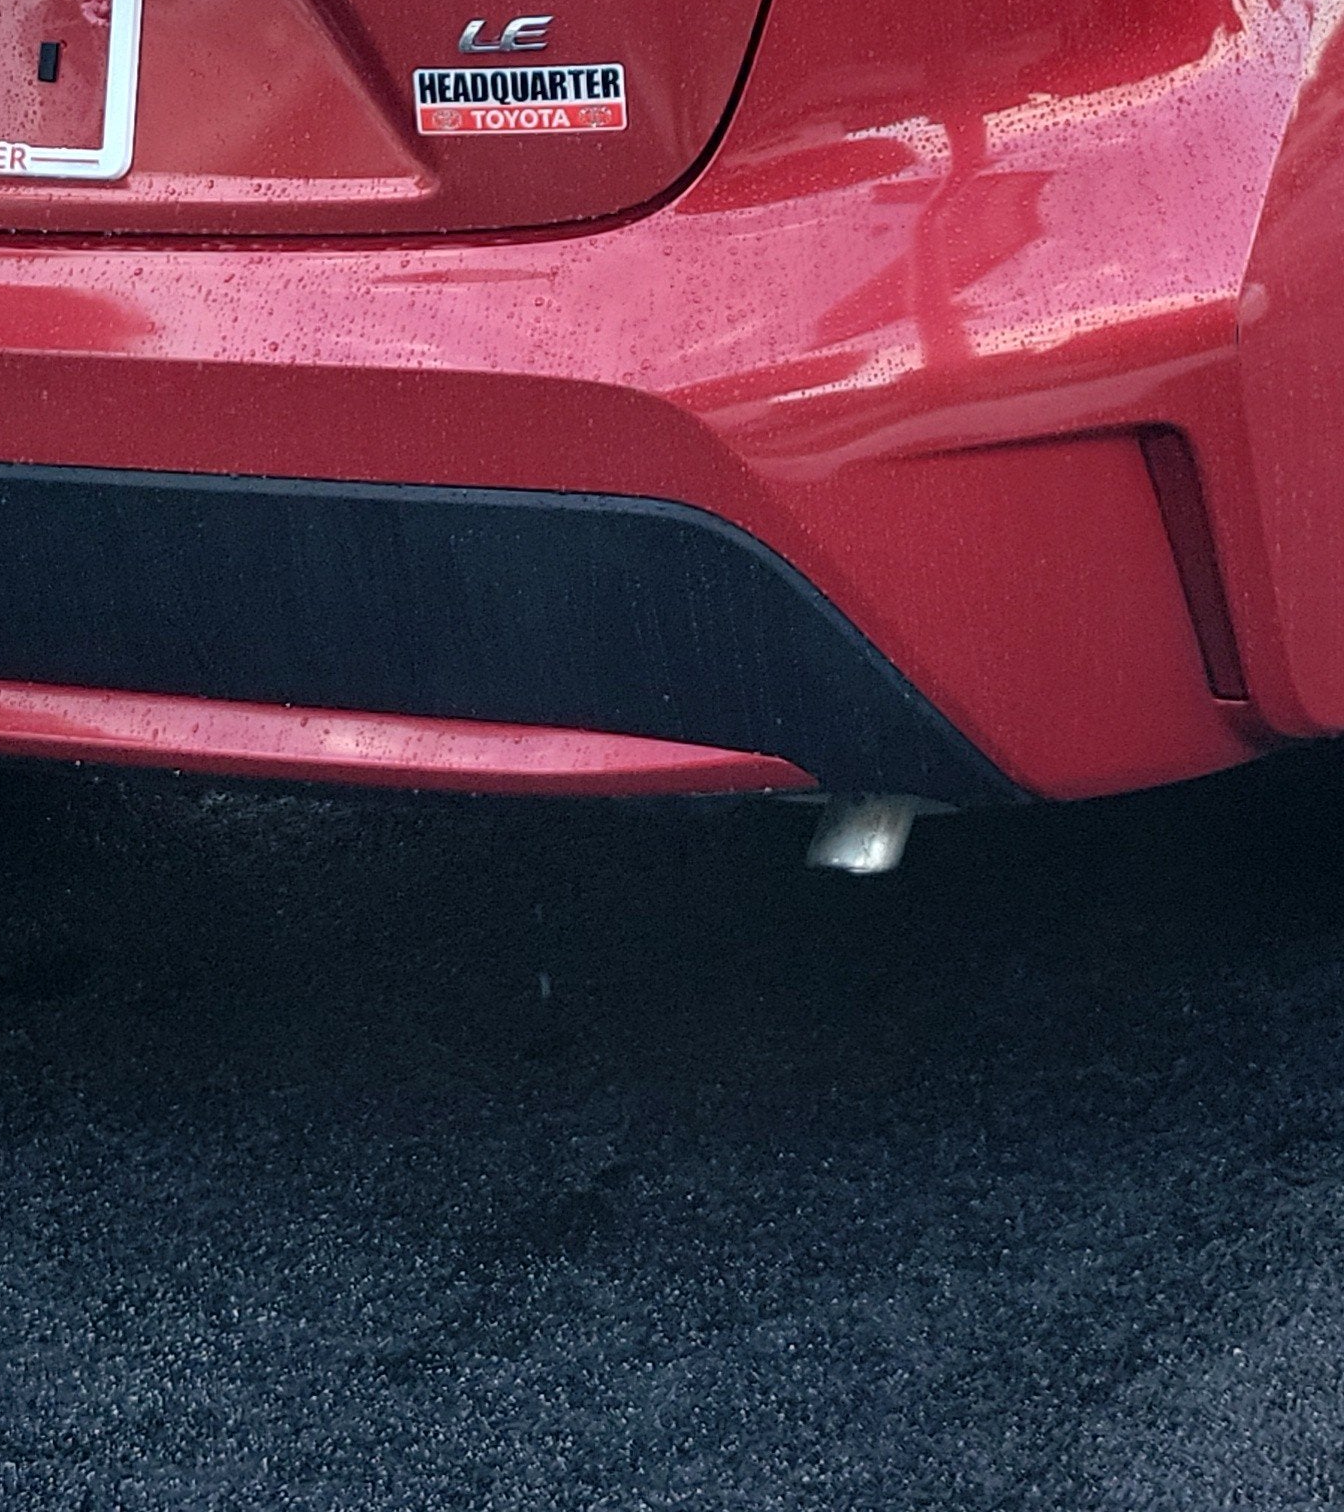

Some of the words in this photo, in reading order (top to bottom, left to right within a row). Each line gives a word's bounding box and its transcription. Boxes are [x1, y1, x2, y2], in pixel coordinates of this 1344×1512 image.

[458, 15, 554, 54] LE
[417, 68, 622, 105] HEADQUARTER
[470, 108, 571, 130] TOYOTA
